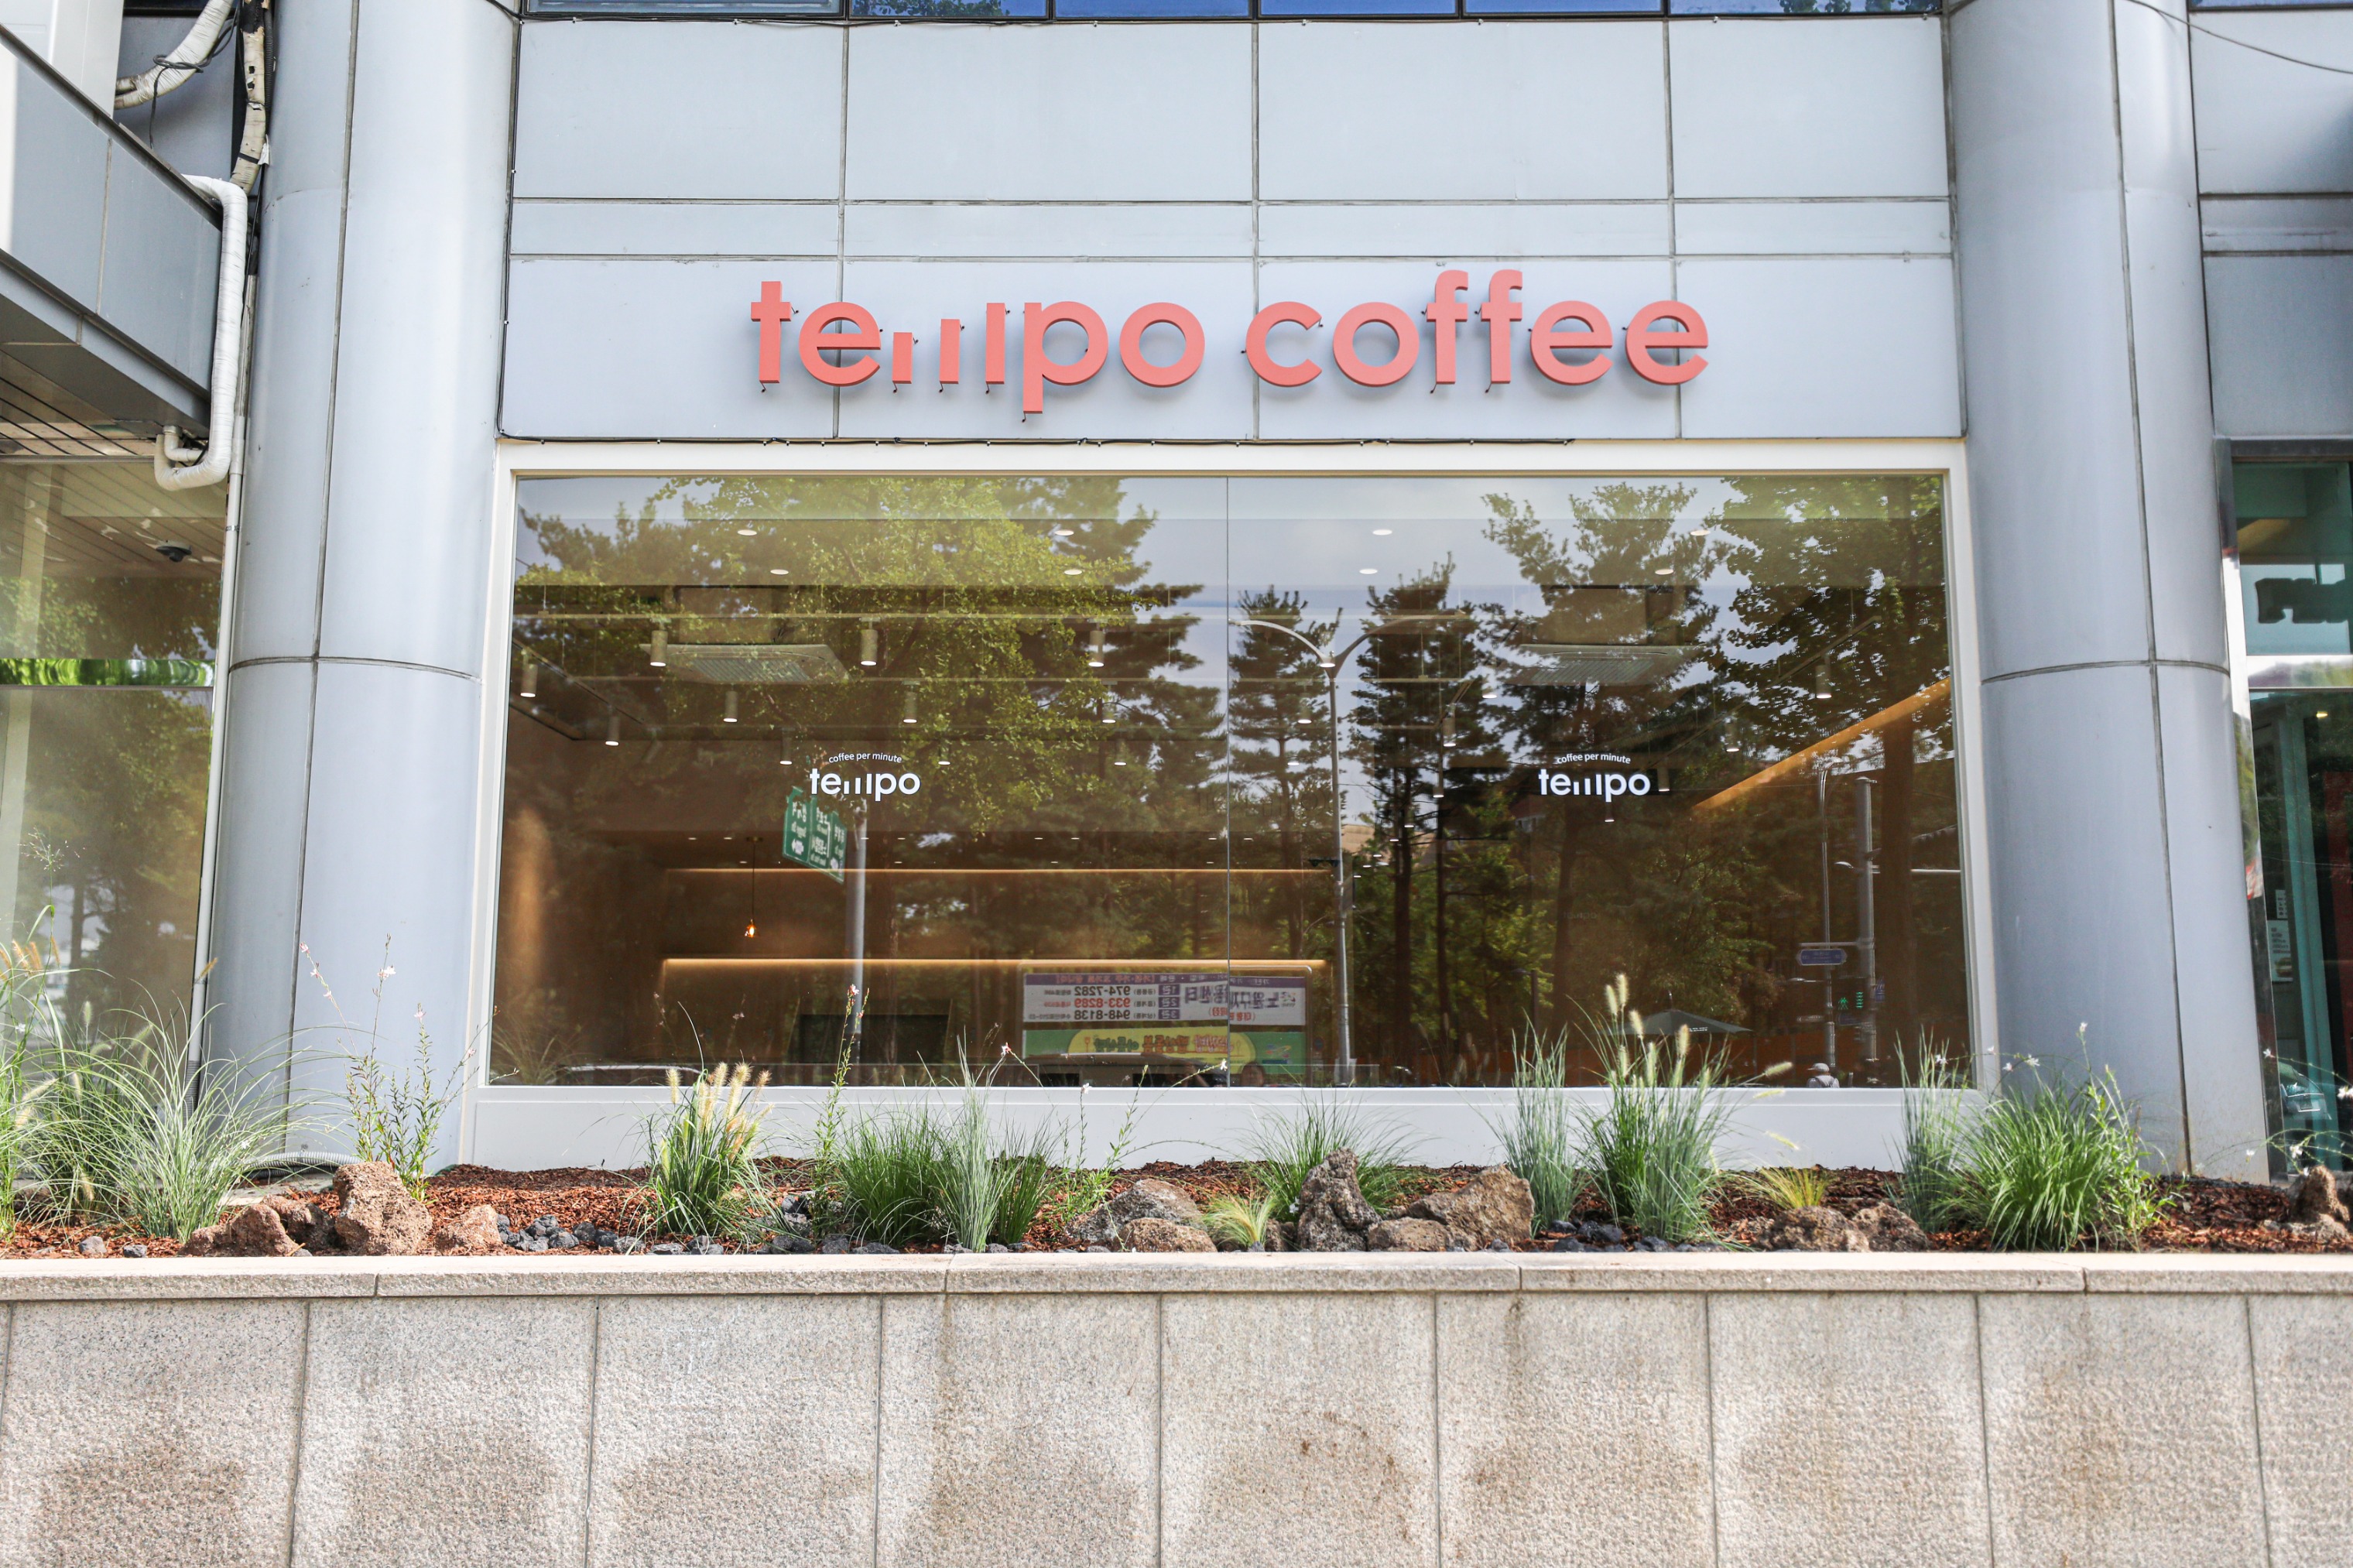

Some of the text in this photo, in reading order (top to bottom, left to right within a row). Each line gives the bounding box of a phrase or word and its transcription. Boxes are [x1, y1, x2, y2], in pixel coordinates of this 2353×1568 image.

[1245, 269, 1708, 387] coffee
[828, 752, 902, 763] coffee per minute
[1557, 753, 1631, 764] coffee per minute
